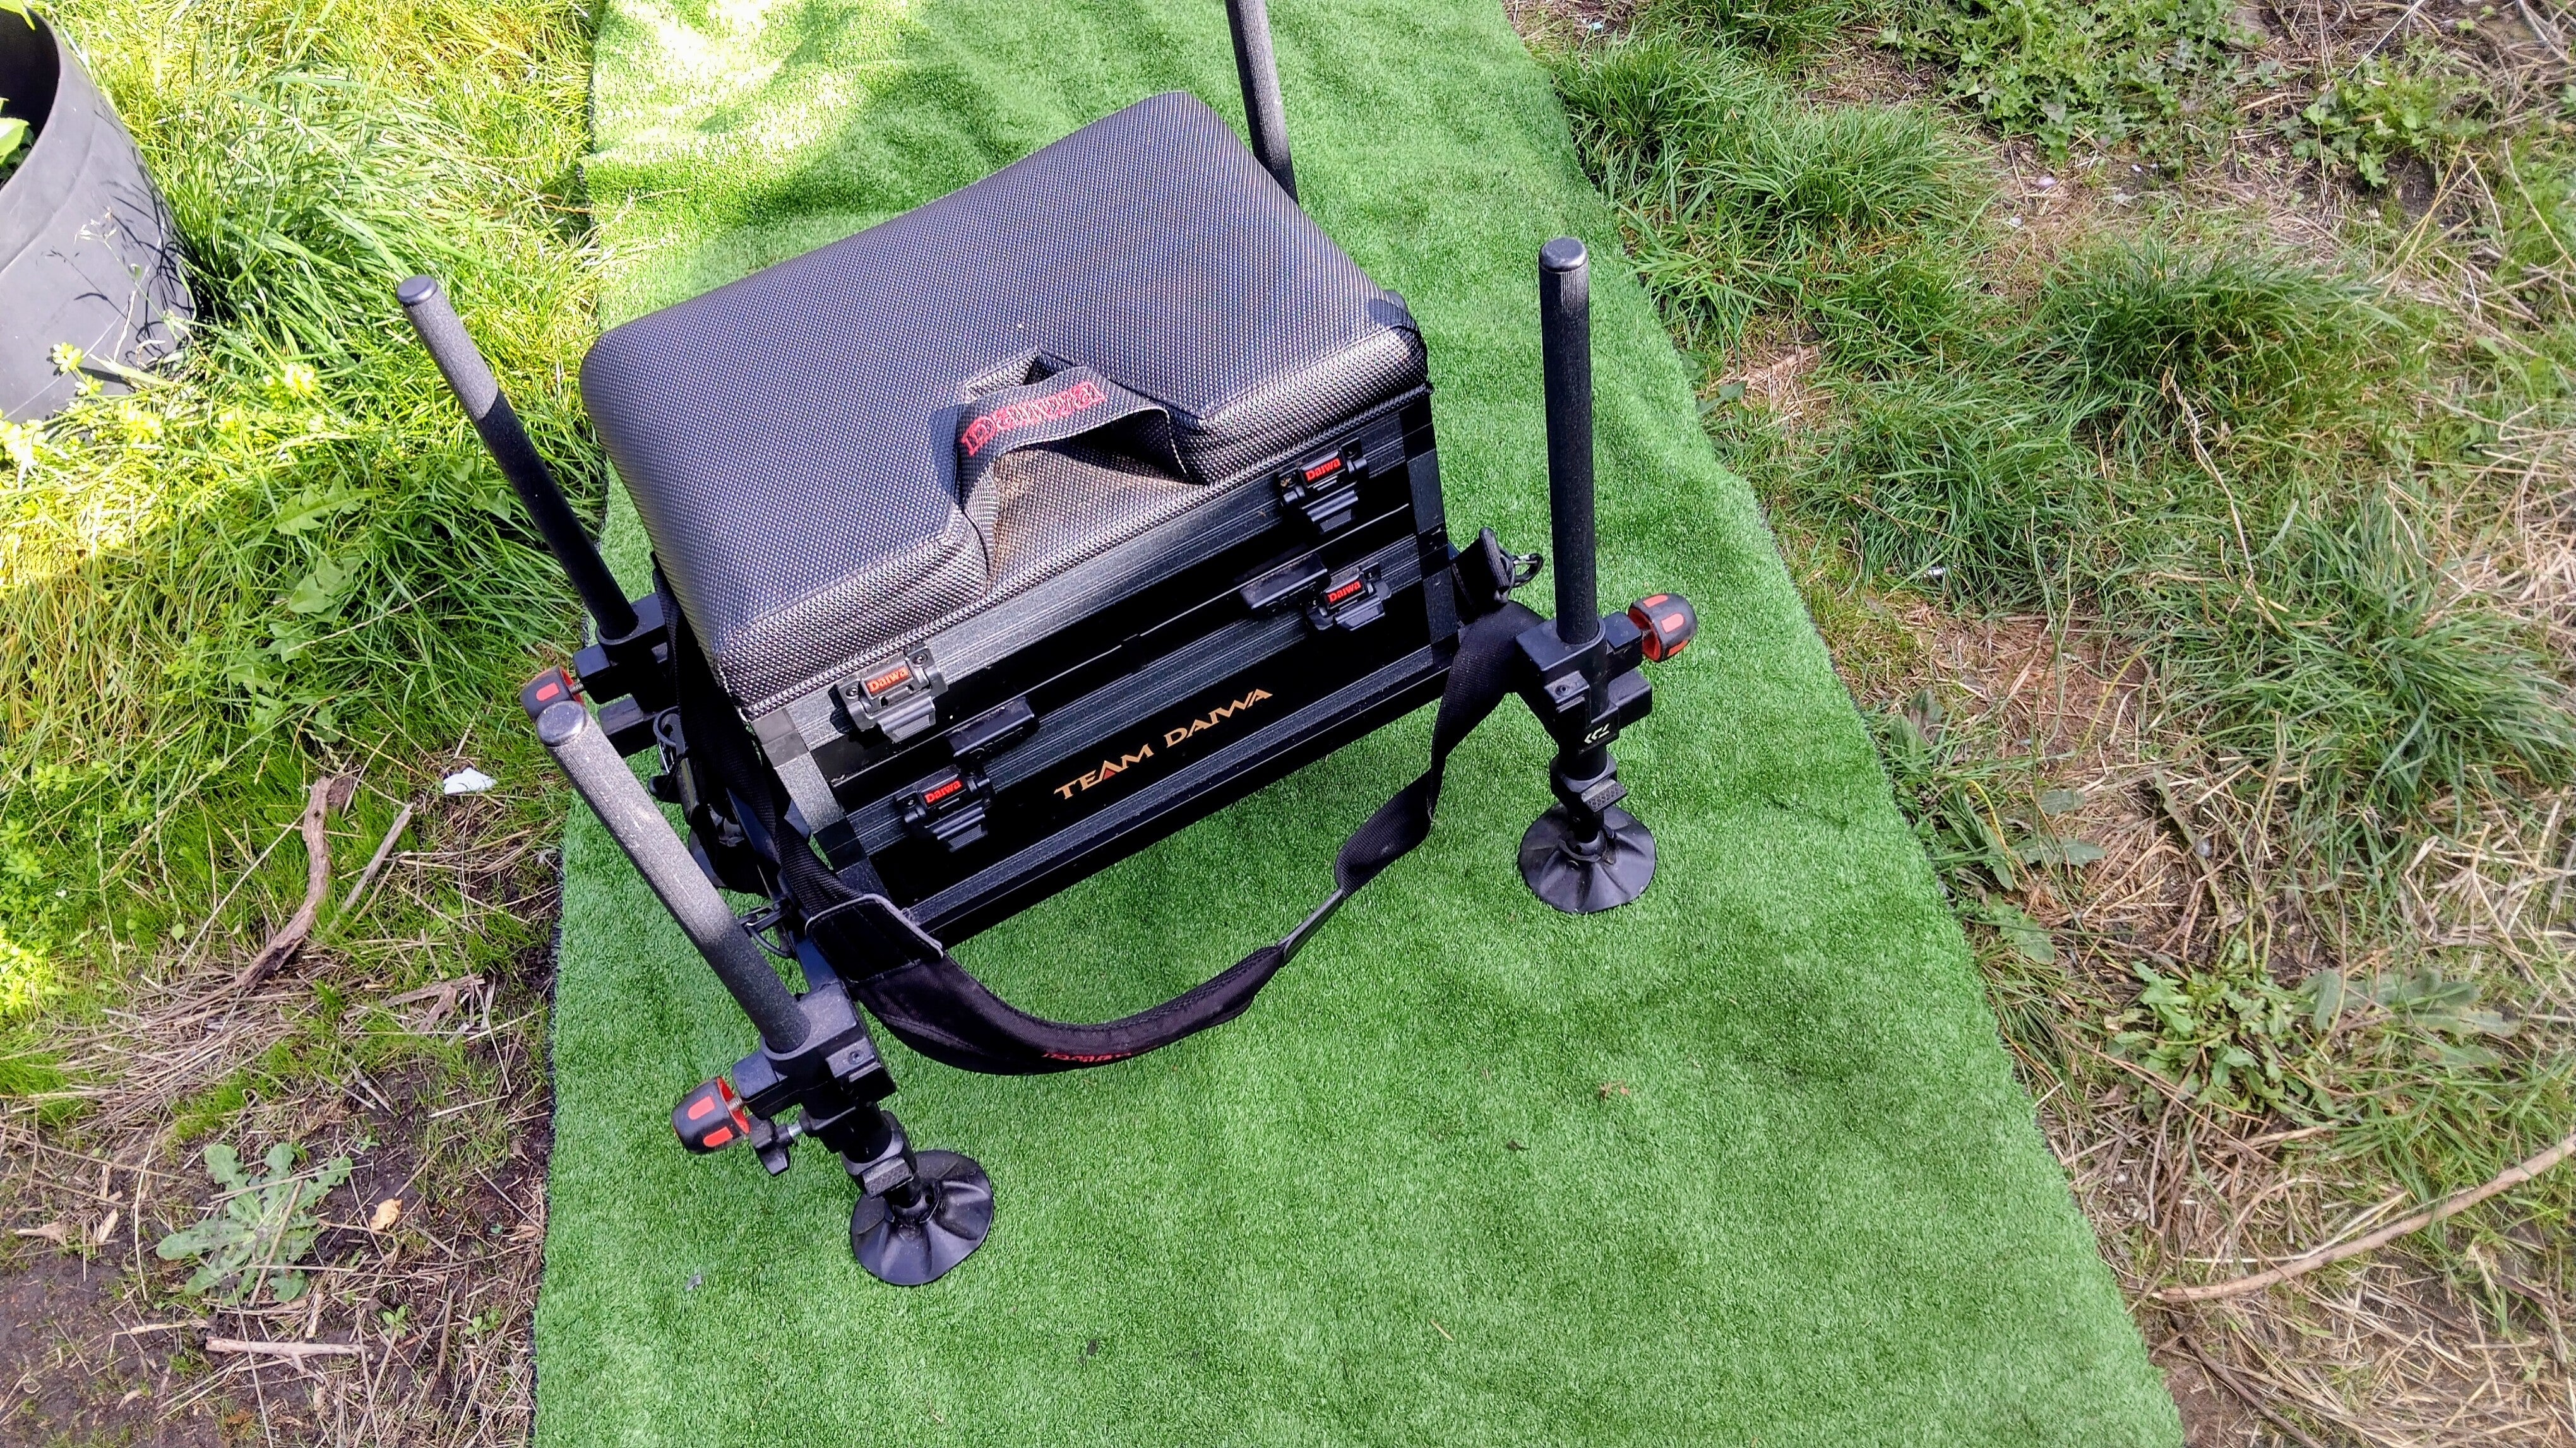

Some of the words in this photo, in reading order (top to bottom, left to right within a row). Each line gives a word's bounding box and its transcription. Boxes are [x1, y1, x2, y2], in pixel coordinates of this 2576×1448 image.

[961, 381, 1106, 456] Daiwa
[1305, 458, 1342, 481] Daiwa
[1328, 581, 1361, 602] Daiwa
[867, 667, 909, 693] Daiwa
[1054, 744, 1154, 800] TEAM
[1164, 689, 1273, 748] DAIWA
[924, 780, 963, 803] Daiwa
